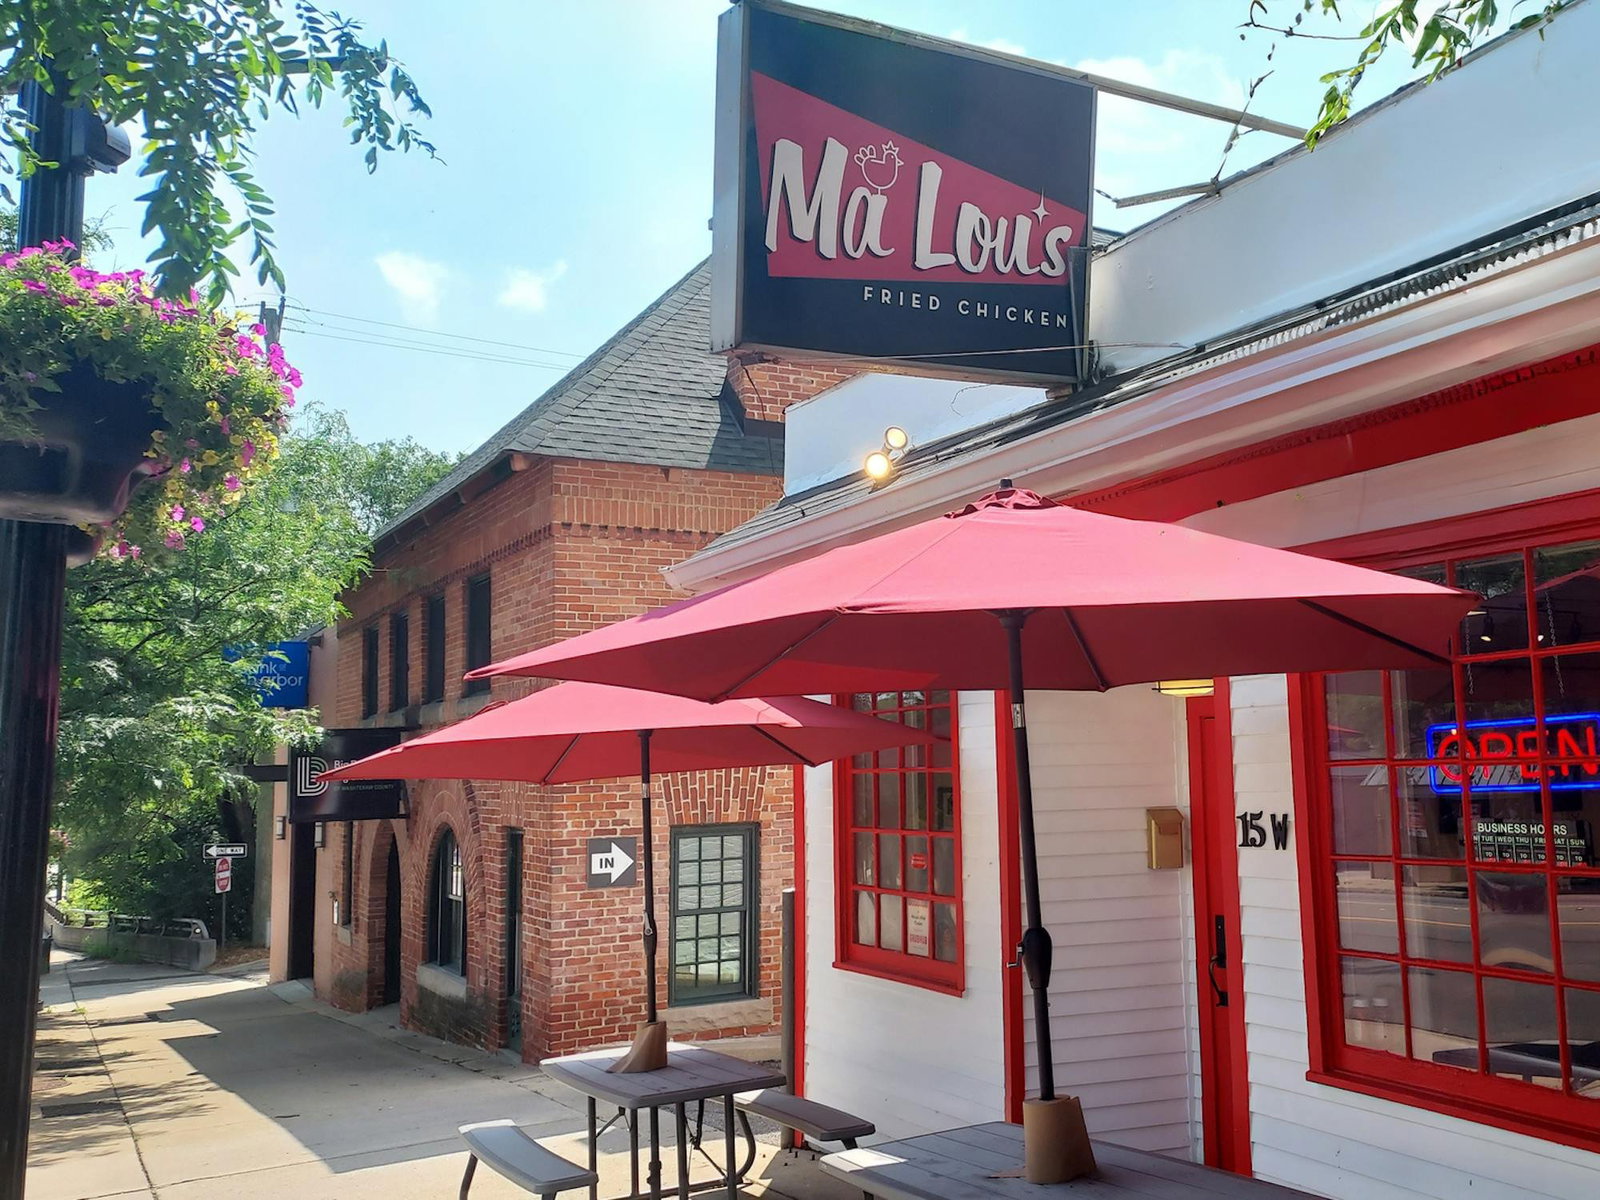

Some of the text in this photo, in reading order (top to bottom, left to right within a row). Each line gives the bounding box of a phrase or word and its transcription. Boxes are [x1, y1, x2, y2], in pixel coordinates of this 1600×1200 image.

[764, 136, 895, 260] Ma
[863, 286, 1068, 328] FRIED CHICKEN
[1437, 726, 1598, 782] OPEN
[1236, 810, 1288, 850] 15 W
[1477, 822, 1568, 835] BUSINESS HORS
[600, 857, 614, 869] IN
